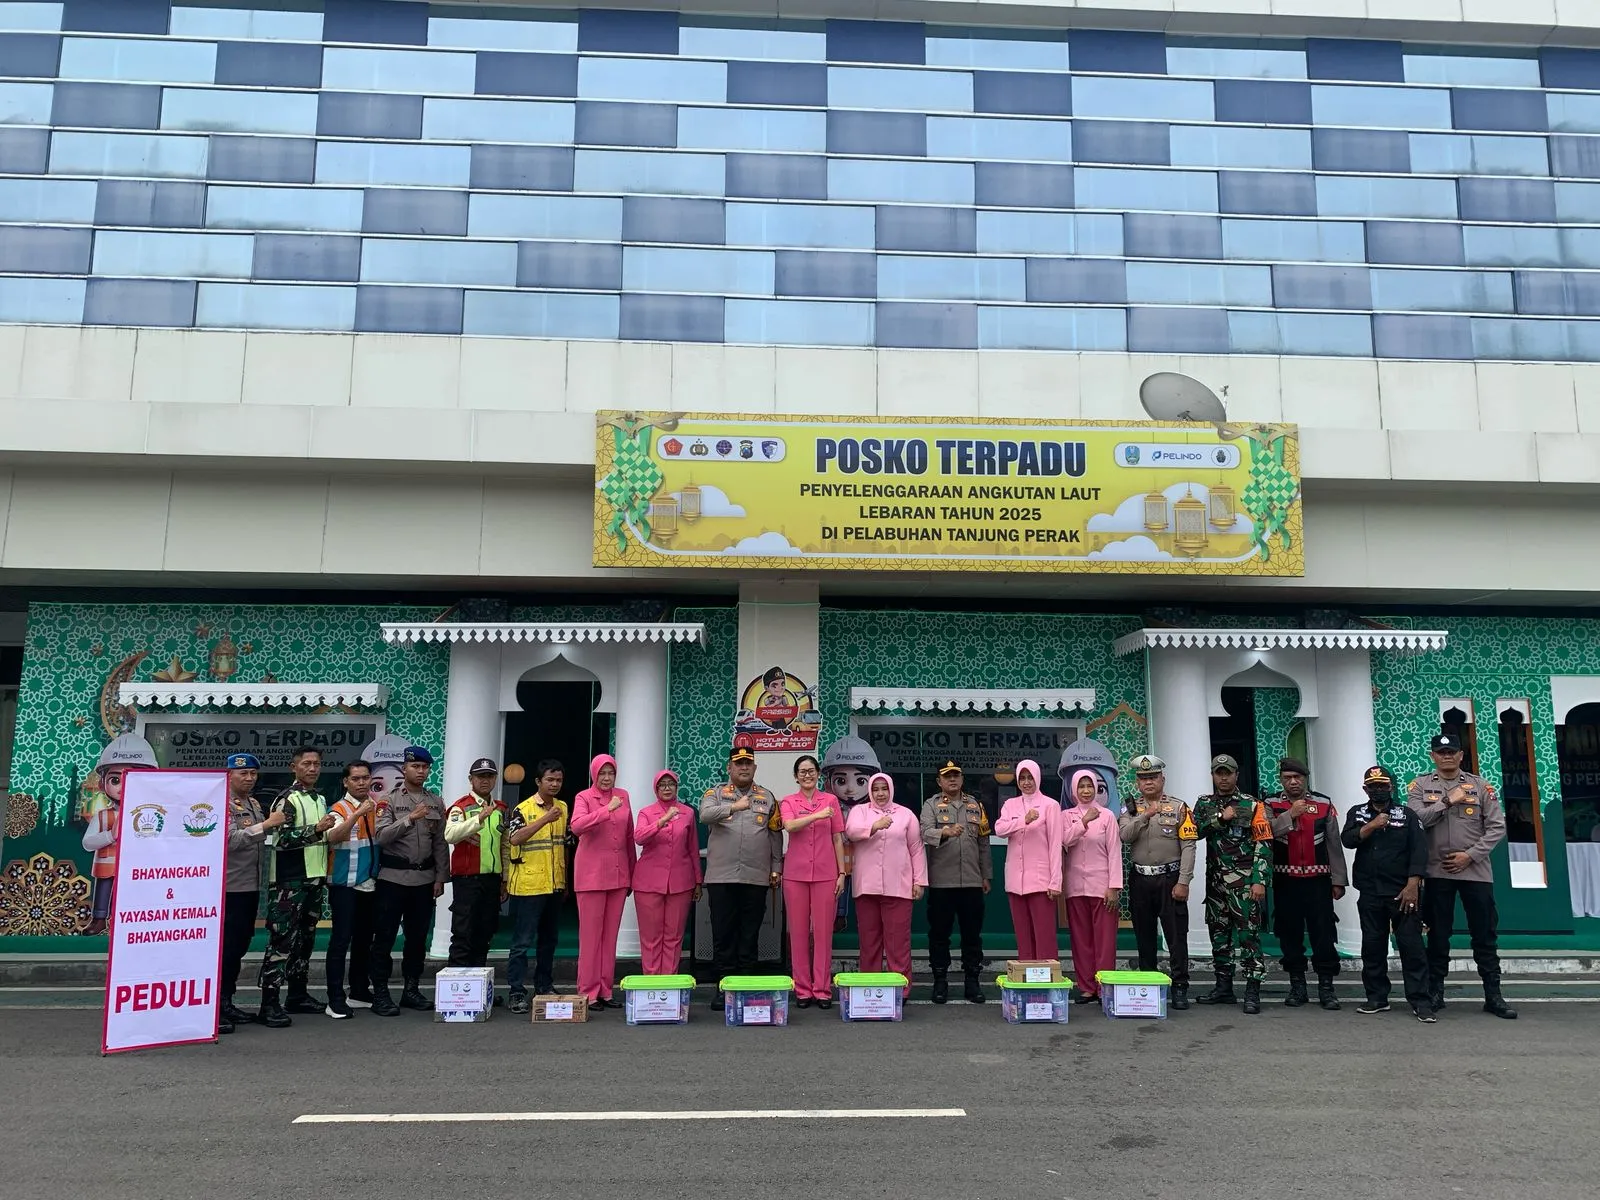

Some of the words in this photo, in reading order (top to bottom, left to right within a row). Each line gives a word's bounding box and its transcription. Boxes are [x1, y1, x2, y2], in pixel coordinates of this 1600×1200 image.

[815, 438, 928, 475] POSKO
[936, 440, 1086, 477] TERPADU
[1163, 452, 1202, 460] PELINDO
[800, 483, 963, 498] PENYELENGGARAAN
[967, 486, 1055, 500] ANGKUTAN
[1061, 487, 1101, 501] LAUT
[859, 505, 936, 519] LEBARAN
[940, 507, 994, 520] TAHUN
[999, 507, 1042, 521] 2025
[821, 526, 838, 540] DI
[843, 527, 942, 541] PELABUHAN
[946, 528, 1020, 542] TANJUNG
[1024, 529, 1080, 543] PERAK
[249, 729, 365, 747] TERPADU
[869, 730, 950, 748] POSKO
[131, 866, 210, 881] BHAYANGKARI
[166, 888, 174, 899] &
[119, 908, 169, 924] YAYASAN
[172, 906, 217, 920] KEMALA
[127, 927, 207, 944] BHAYANGKARI
[114, 978, 212, 1014] PEDULI
